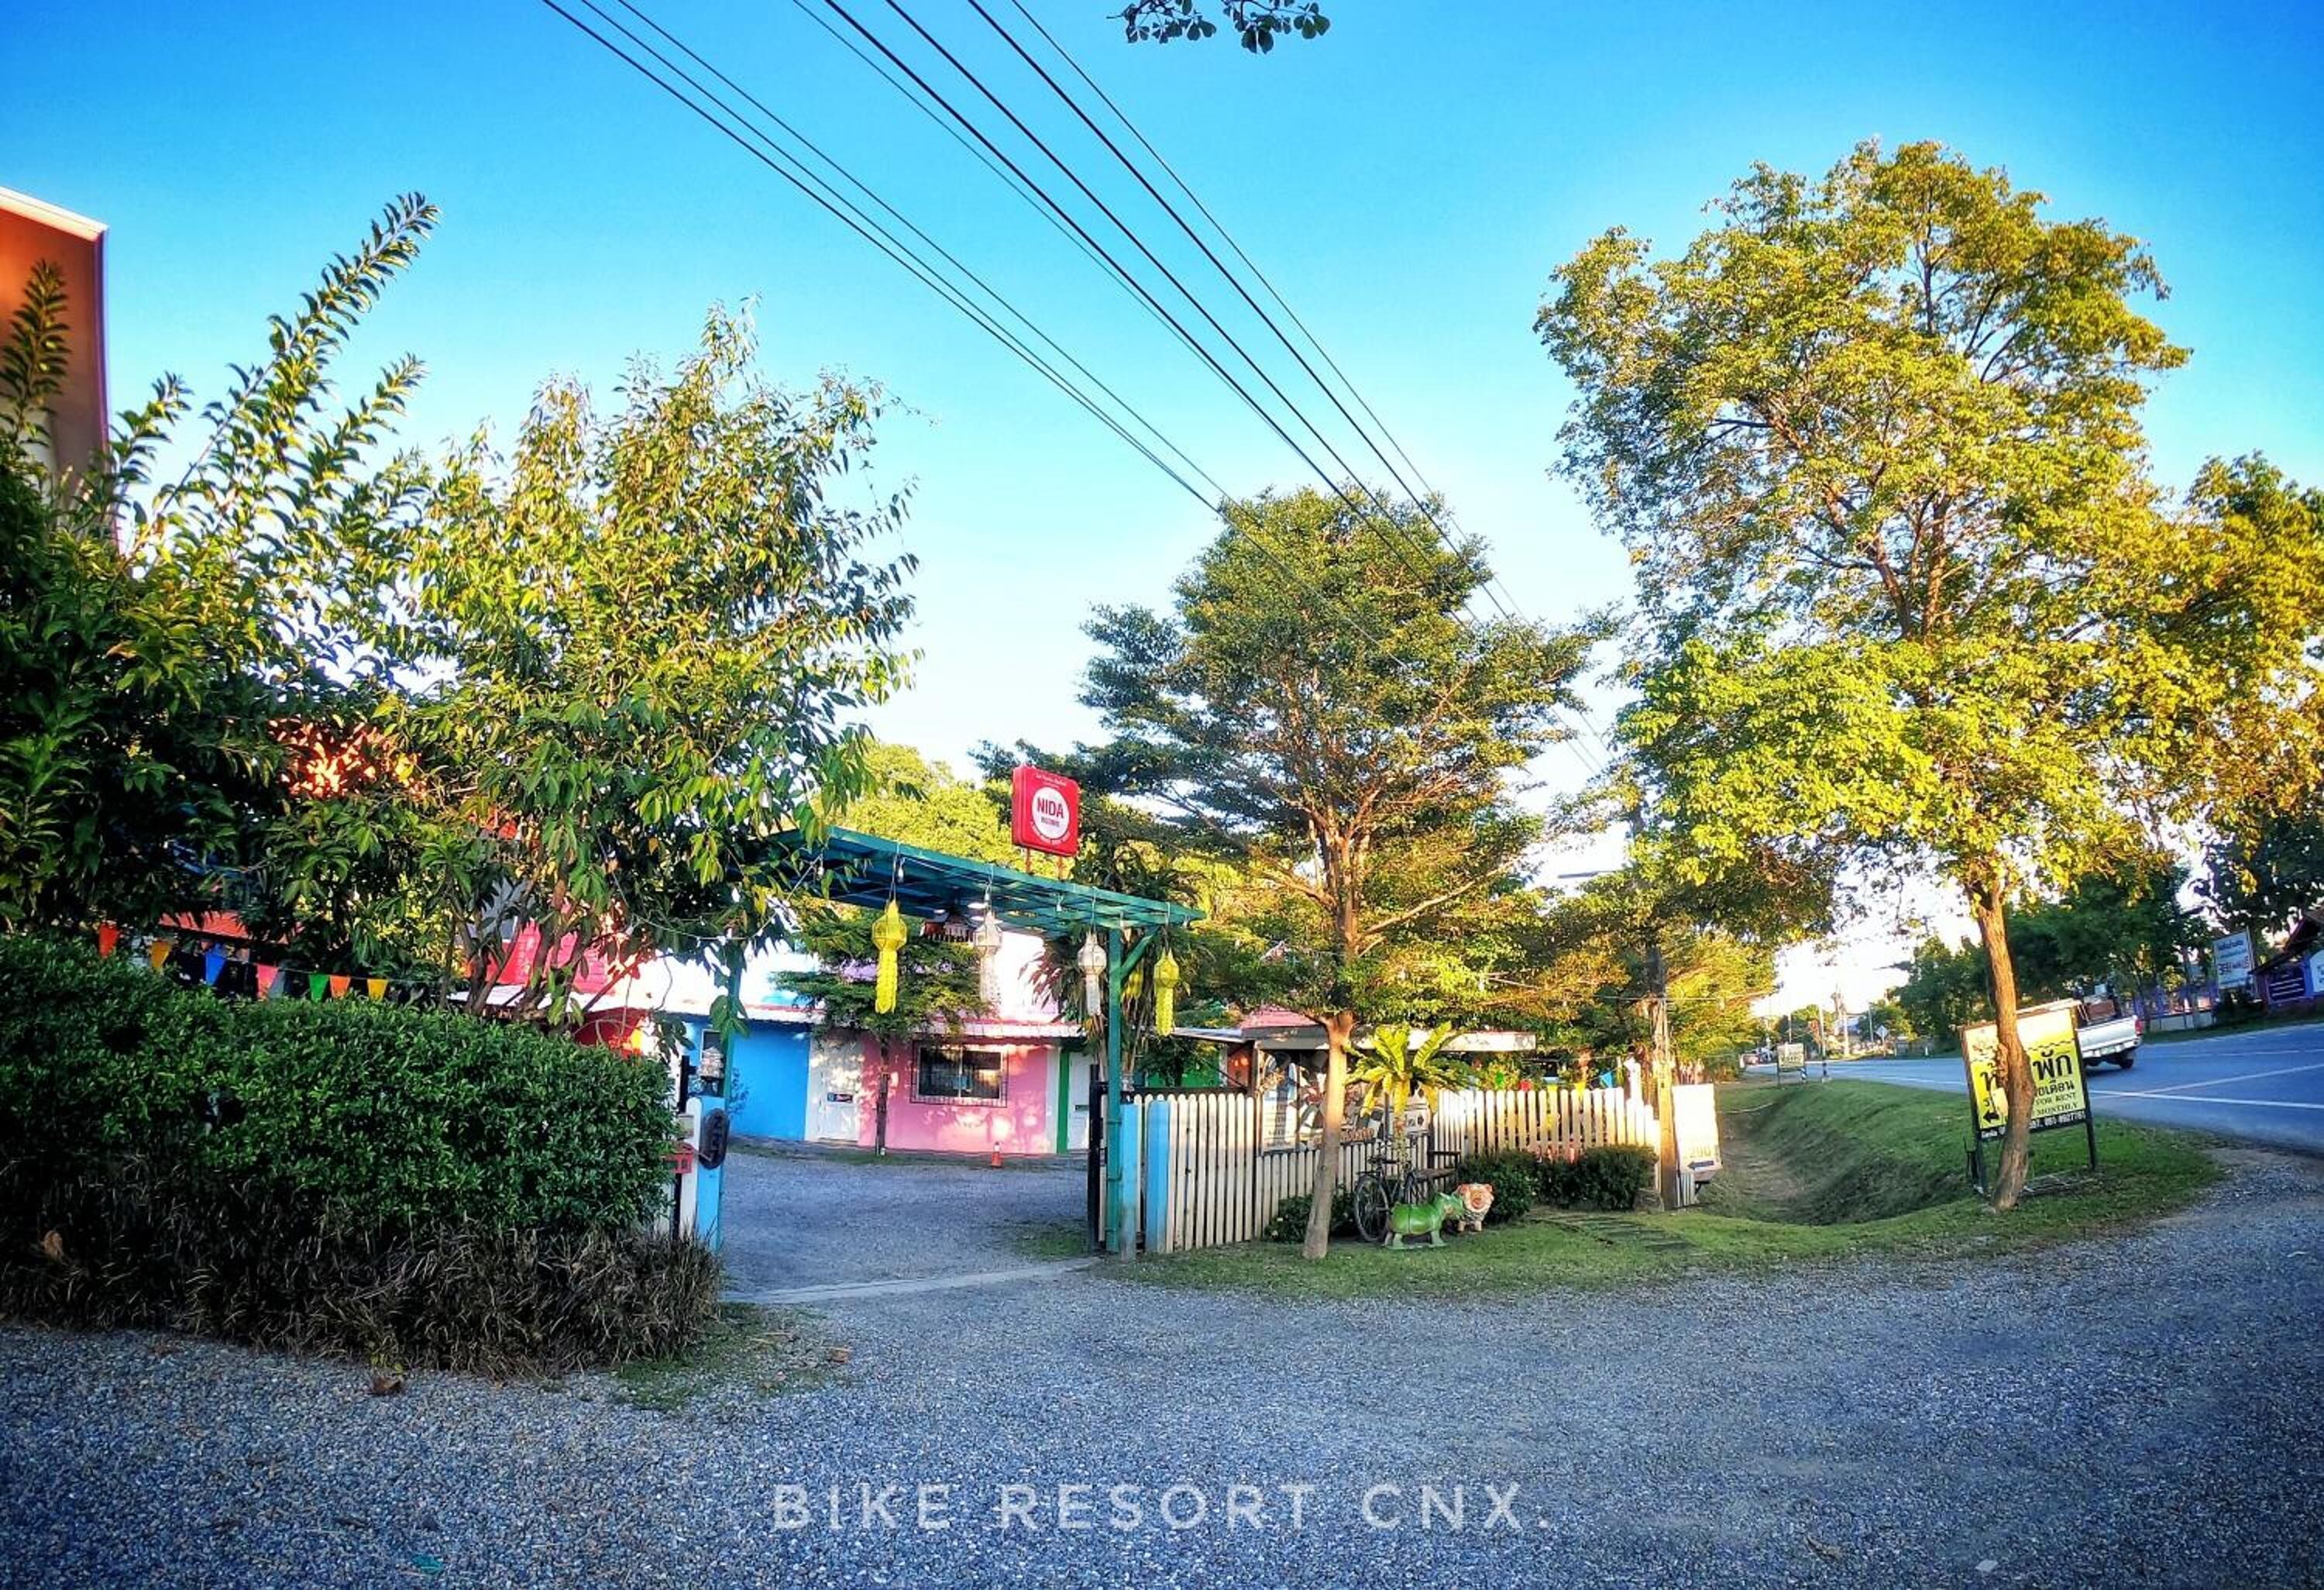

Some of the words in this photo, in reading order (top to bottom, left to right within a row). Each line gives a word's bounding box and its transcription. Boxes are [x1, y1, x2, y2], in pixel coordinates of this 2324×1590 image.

[1037, 797, 1064, 818] NIDA
[2055, 1092, 2077, 1103] RENT
[2037, 1101, 2078, 1116] MONTHLY
